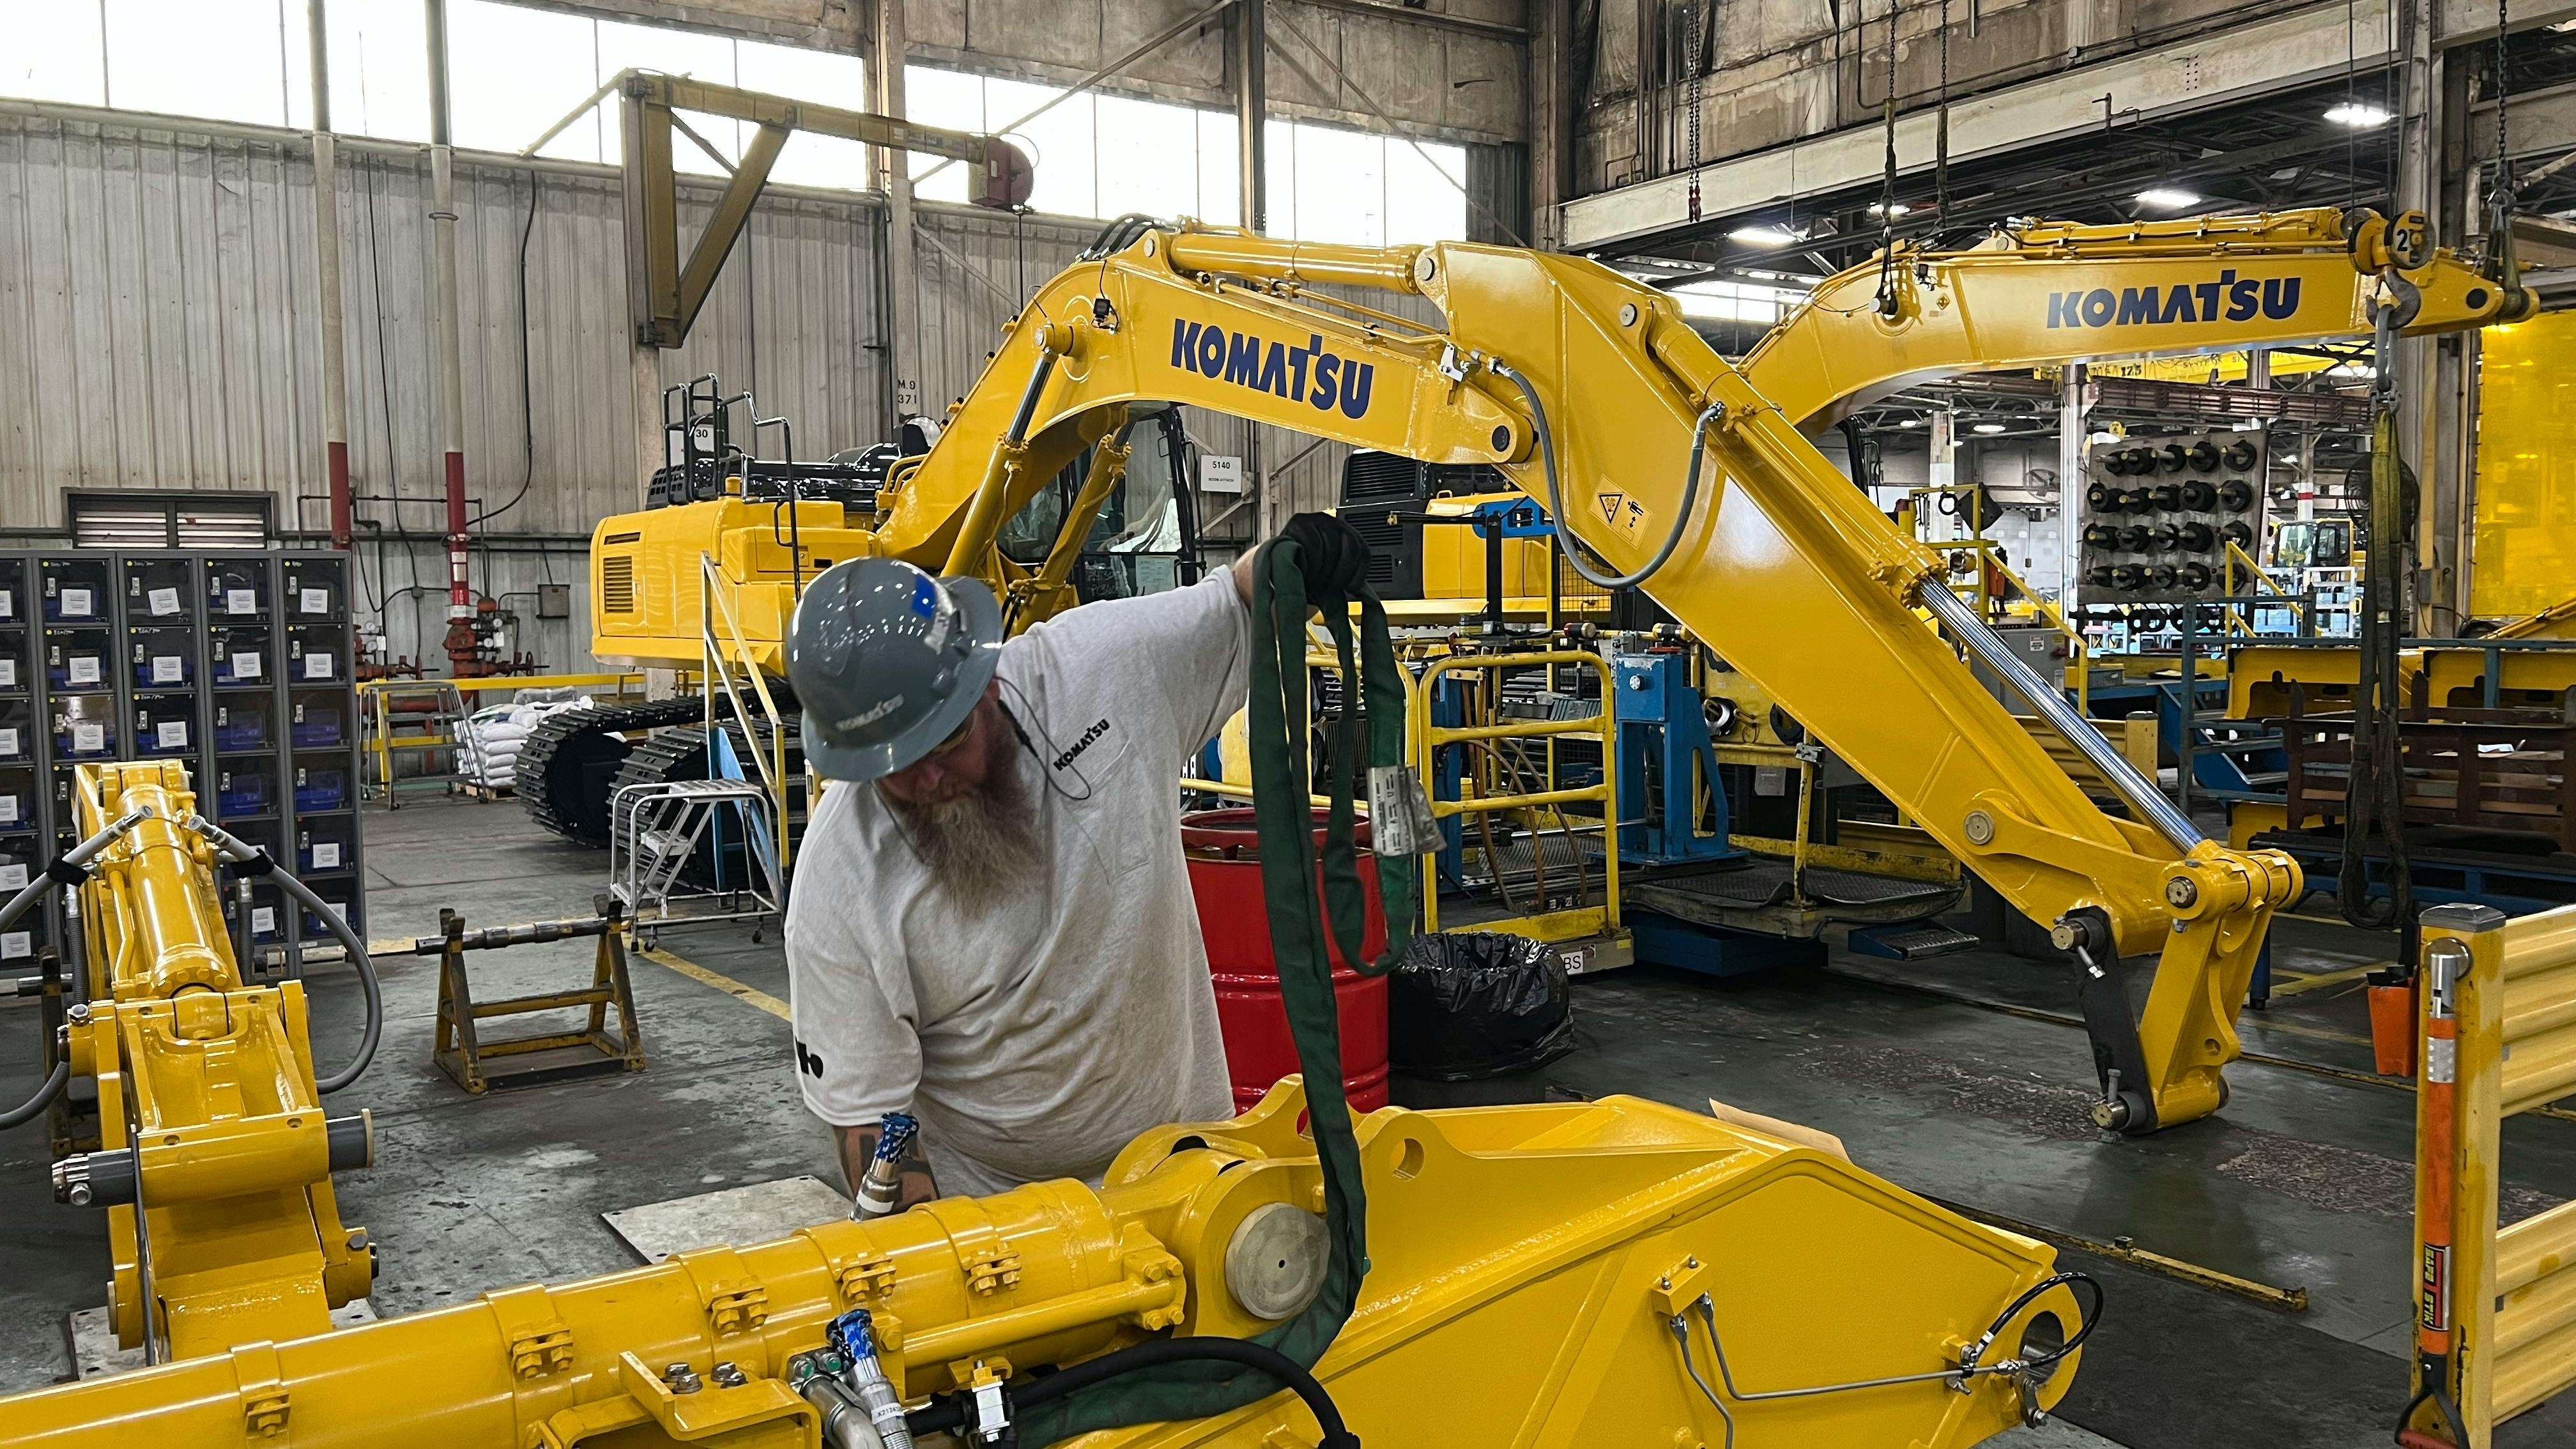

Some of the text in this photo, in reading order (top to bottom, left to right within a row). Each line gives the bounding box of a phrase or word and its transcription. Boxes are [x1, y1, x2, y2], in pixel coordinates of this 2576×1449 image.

[2396, 229, 2408, 252] 2
[2047, 270, 2301, 328] KOMATSU
[1171, 318, 1374, 419] KOMATSU
[898, 394, 917, 404] 371
[1053, 719, 1110, 771] KOMATSU
[2424, 1292, 2434, 1325] STIK
